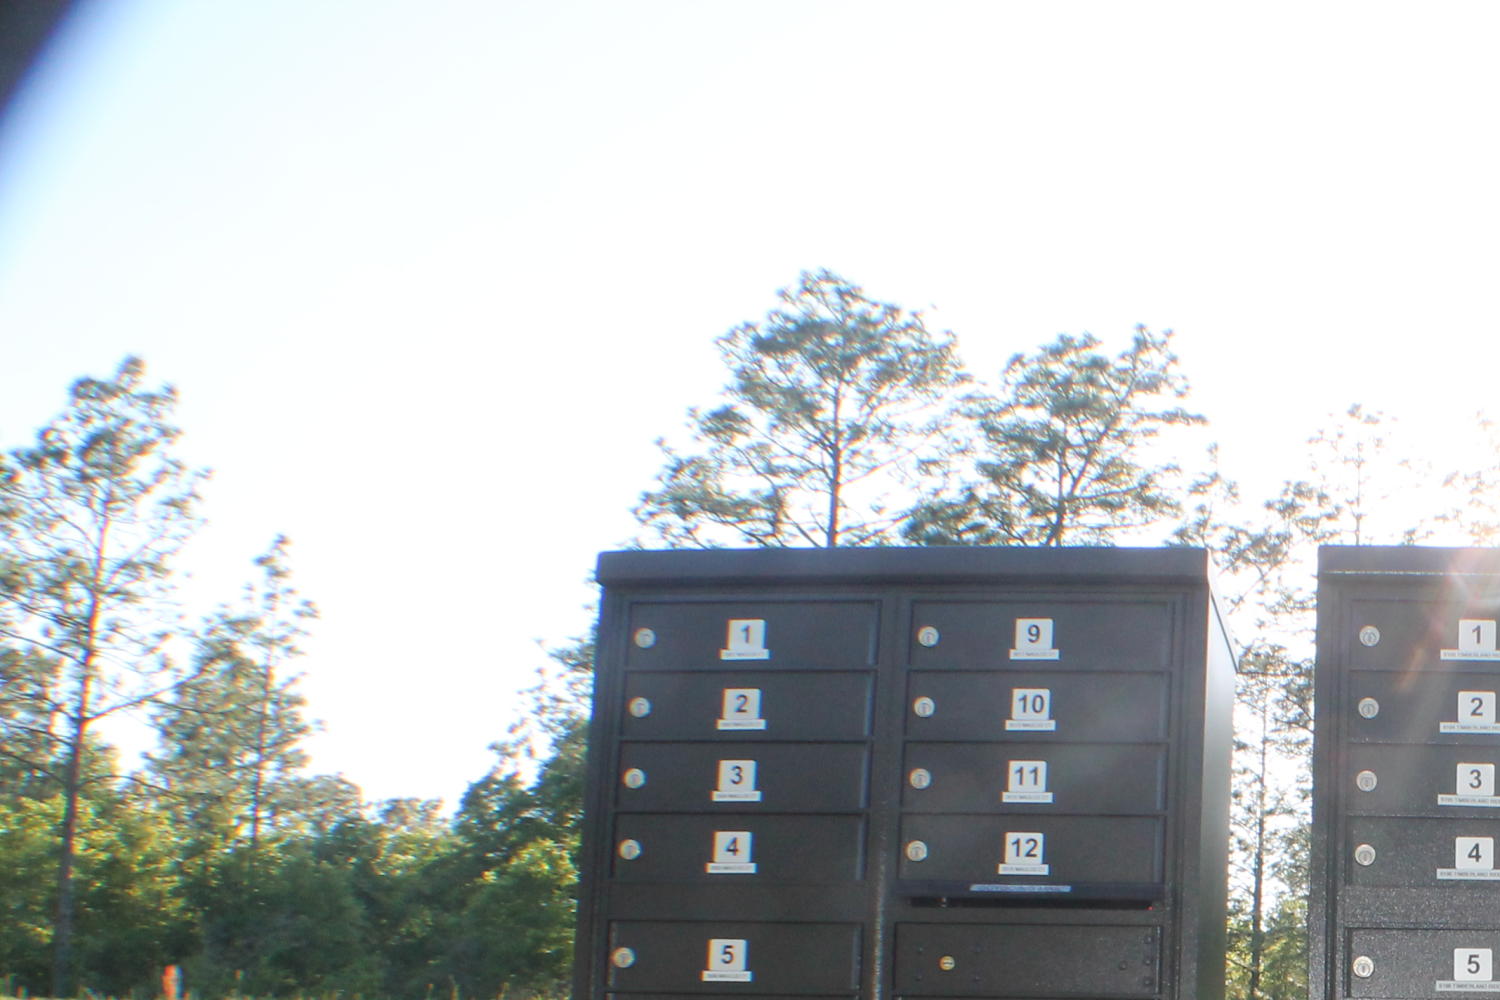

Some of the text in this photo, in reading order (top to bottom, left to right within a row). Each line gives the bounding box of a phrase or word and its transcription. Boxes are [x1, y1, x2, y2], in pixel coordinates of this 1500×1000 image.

[742, 625, 751, 644] 1
[1027, 624, 1041, 644] 9
[1472, 624, 1481, 645] 1
[735, 694, 749, 714] 2
[1018, 694, 1045, 714] 10
[1470, 697, 1484, 717] 2
[730, 765, 743, 785] 3
[1015, 766, 1039, 786] 11
[1469, 769, 1482, 790] 3
[725, 837, 739, 857] 4
[1011, 837, 1038, 858] 12
[1467, 842, 1482, 863] 4
[721, 944, 734, 965] 5
[1467, 954, 1481, 975] 5
